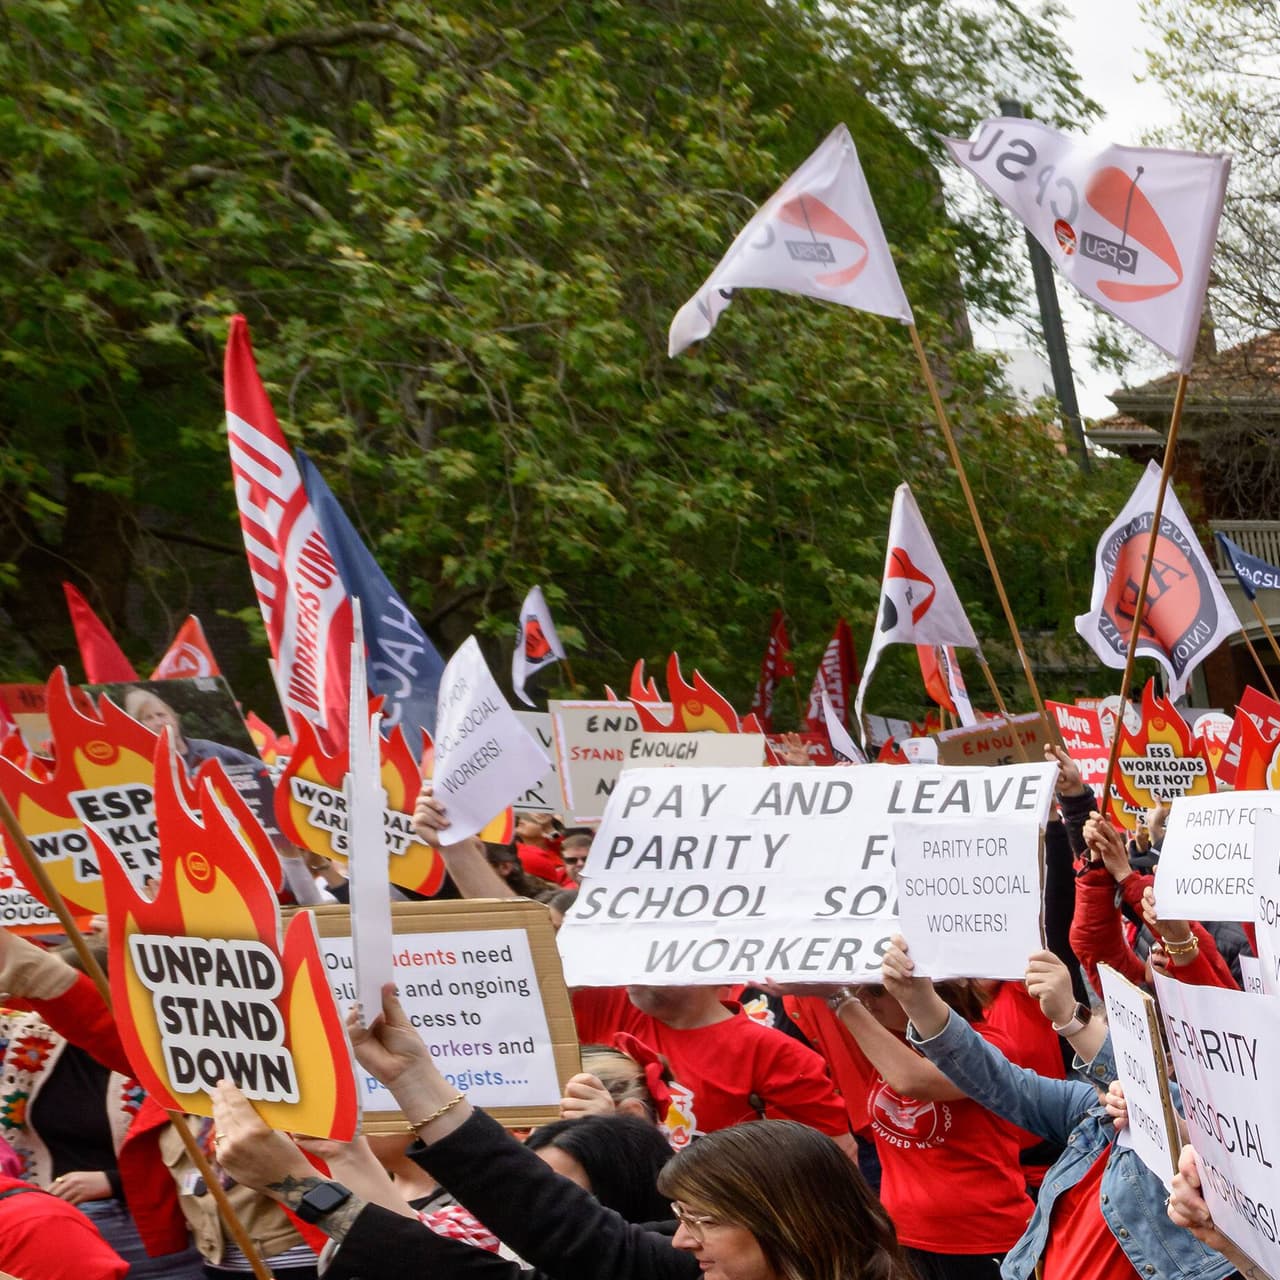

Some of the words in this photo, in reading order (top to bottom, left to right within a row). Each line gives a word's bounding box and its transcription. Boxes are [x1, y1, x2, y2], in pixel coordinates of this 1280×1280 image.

[287, 580, 323, 712] WORKERS
[586, 714, 639, 733] END
[1056, 707, 1091, 734] More
[629, 738, 700, 760] ENOUGH
[1150, 747, 1171, 758] ESS
[442, 736, 504, 796] WORKERS!
[1122, 761, 1203, 772] WORKLOADS
[1137, 776, 1161, 786] ARE
[1163, 775, 1191, 786] NOT
[621, 783, 728, 819] PAY
[752, 780, 855, 817] AND
[885, 774, 1043, 816] LEAVE
[1153, 788, 1182, 798] SAFE
[1186, 808, 1233, 829] PARITY
[604, 833, 790, 871] PARITY
[923, 838, 970, 859] PARITY
[977, 837, 1008, 858] FOR
[1192, 842, 1252, 861] SOCIAL
[905, 877, 968, 898] SCHOOL
[972, 874, 1031, 896] SOCIAL
[1175, 876, 1254, 896] WORKERS
[574, 883, 768, 920] SCHOOL
[927, 912, 1008, 934] WORKERS!
[137, 943, 278, 991] UNPAID
[463, 945, 513, 965] need
[644, 936, 897, 974] WORKERS
[406, 982, 445, 999] and
[449, 976, 531, 1000] ongoing
[160, 995, 279, 1042] STAND
[460, 1009, 482, 1026] to
[430, 1039, 494, 1058] orkers
[498, 1036, 536, 1055] and
[1181, 1019, 1258, 1081] PARITY
[168, 1046, 293, 1096] DOWN
[870, 1121, 912, 1150] DIVIDED
[1201, 1104, 1274, 1170] SOCIAL
